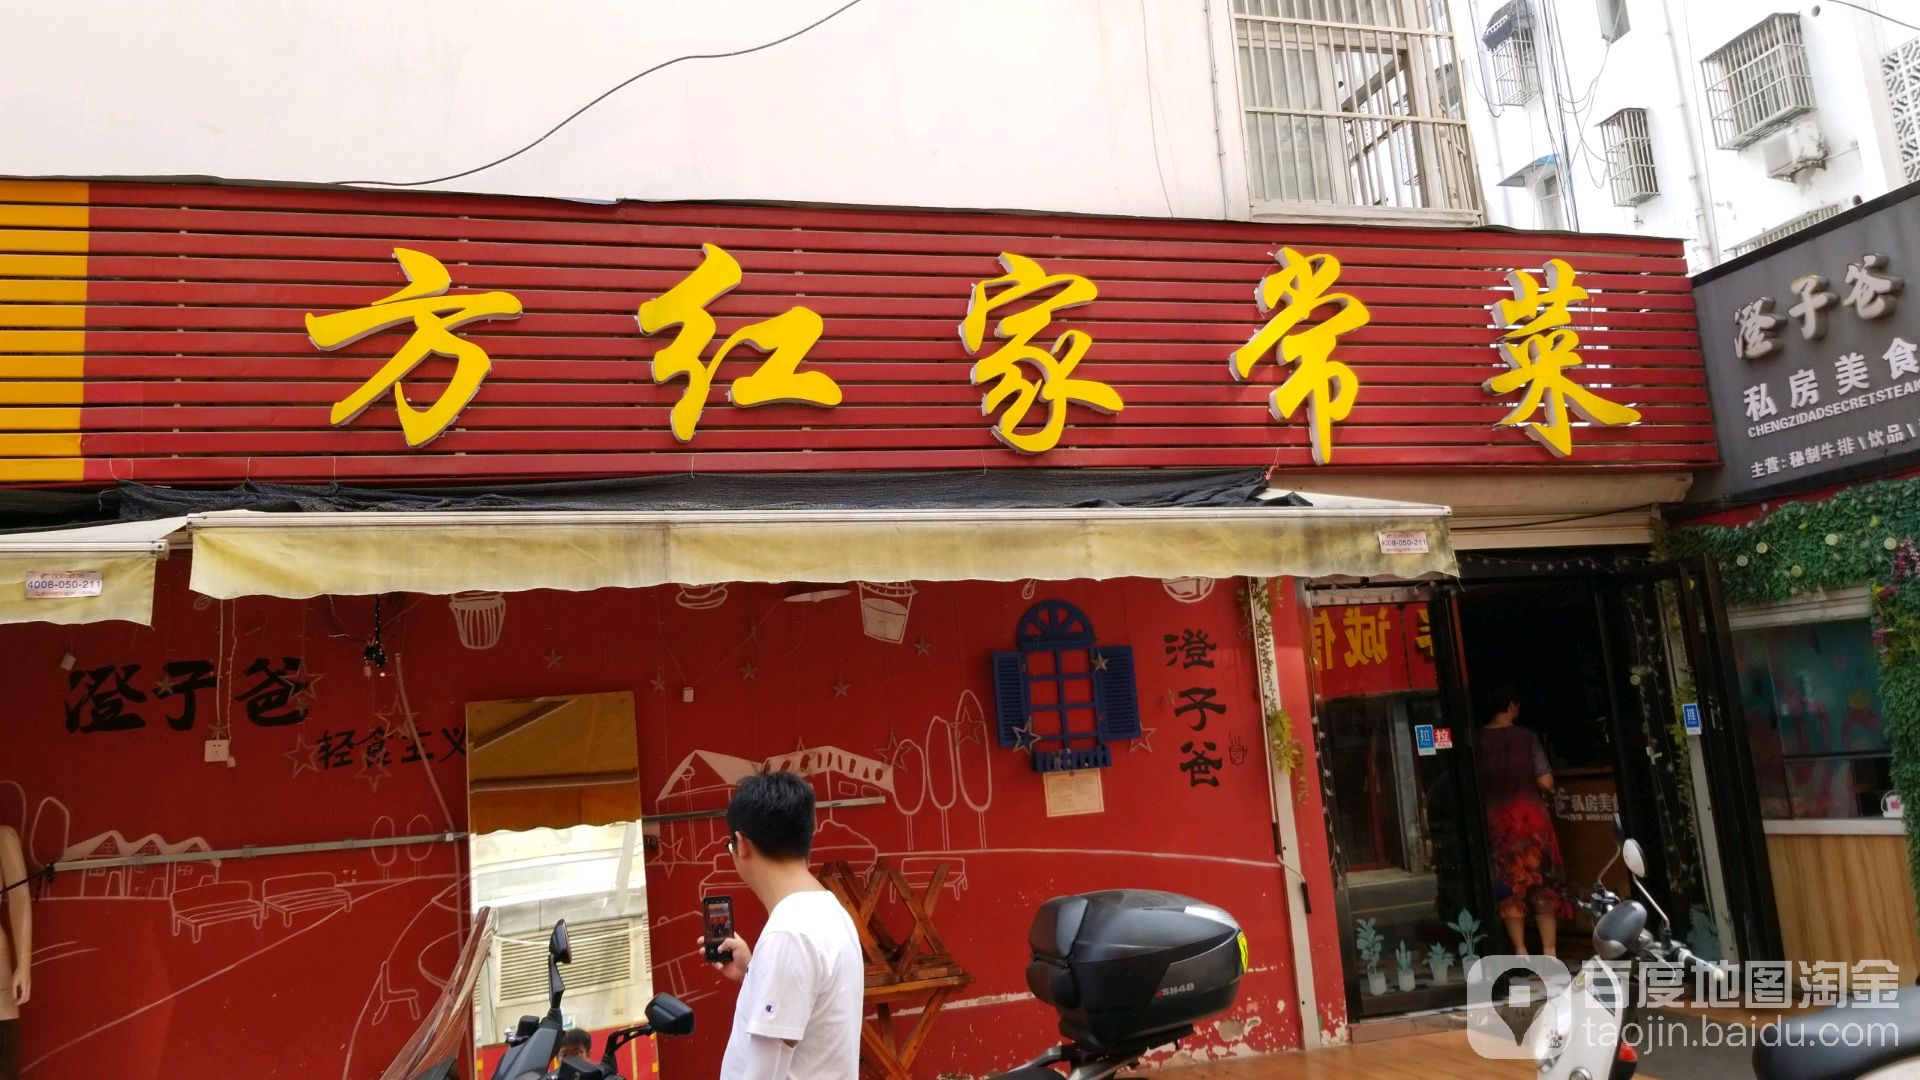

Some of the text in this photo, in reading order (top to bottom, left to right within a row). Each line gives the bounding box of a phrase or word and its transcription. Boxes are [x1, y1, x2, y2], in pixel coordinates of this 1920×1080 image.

[1734, 253, 1900, 359] 澄子爸
[304, 243, 1642, 465] 方红家常菜
[1743, 337, 1920, 422] 私房美食
[27, 580, 101, 589] 4008-050-211
[64, 656, 309, 734] 澄子爸
[1164, 628, 1226, 788] 澄子爸
[316, 722, 467, 771] 轻食主义
